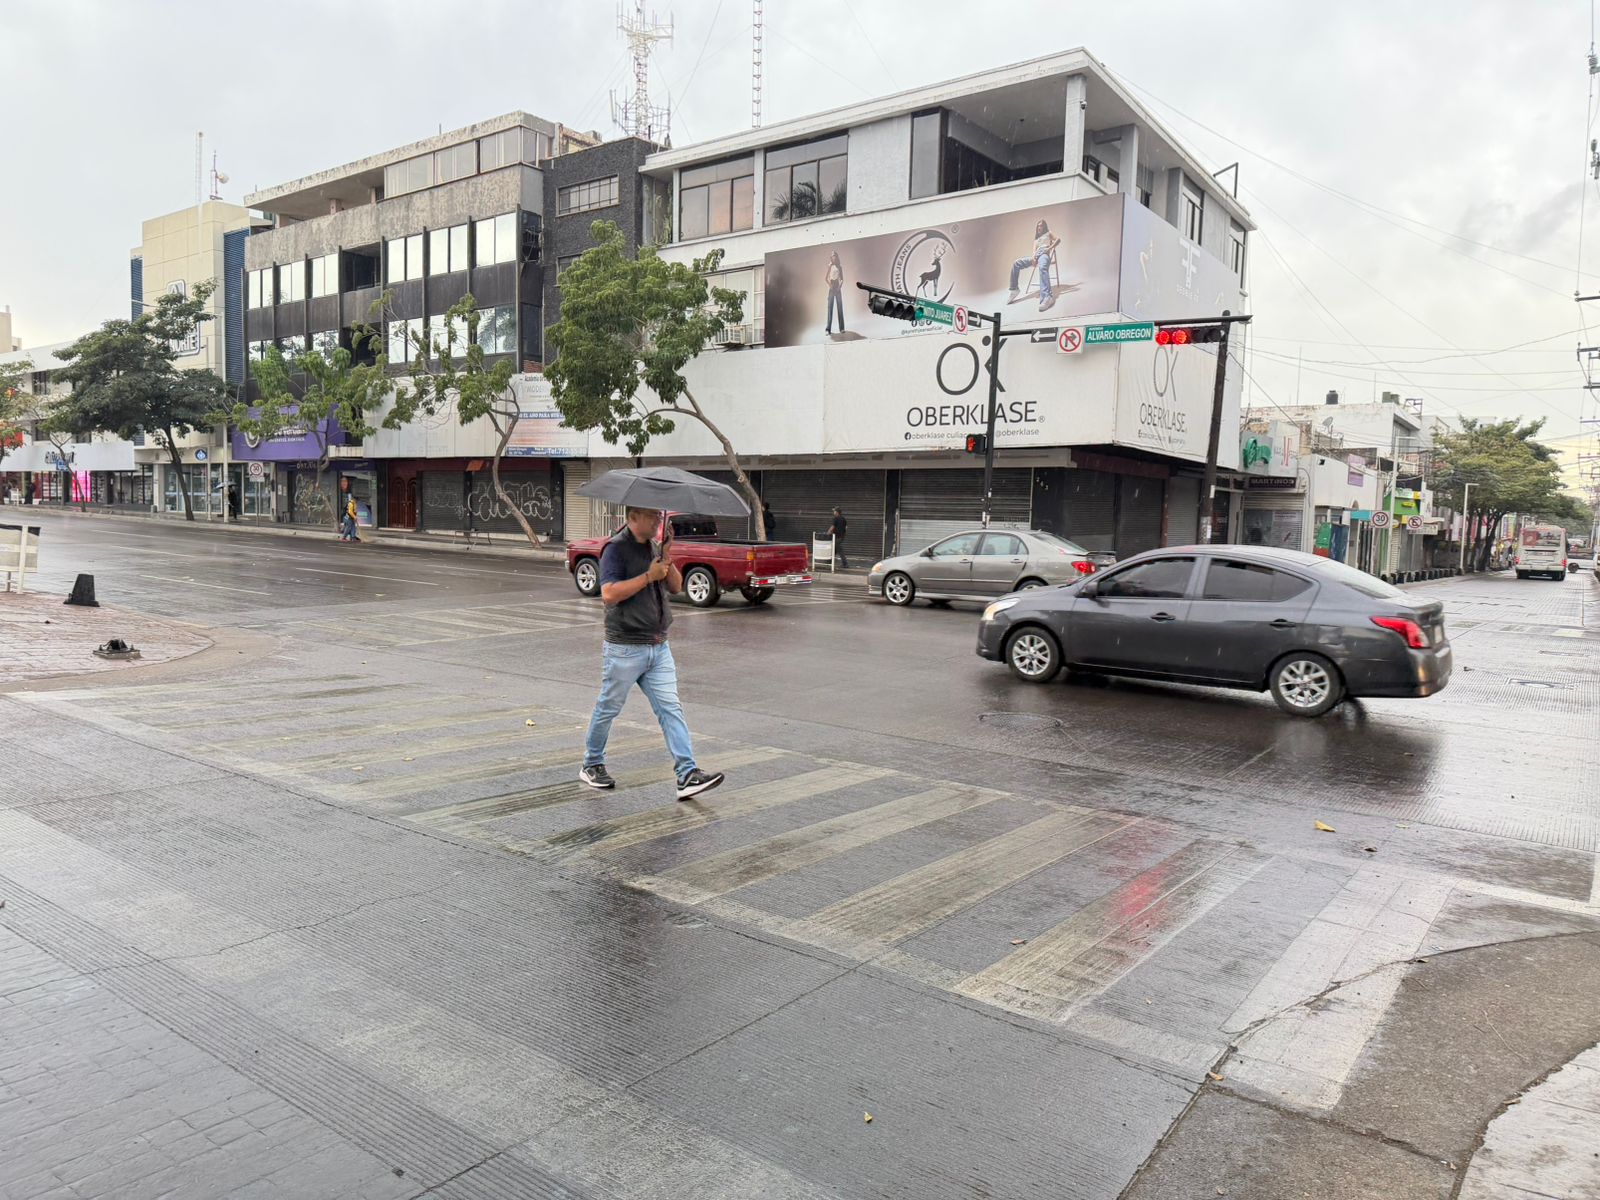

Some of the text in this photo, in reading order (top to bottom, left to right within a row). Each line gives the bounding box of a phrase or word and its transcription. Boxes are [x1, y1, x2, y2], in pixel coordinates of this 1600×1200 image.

[924, 306, 935, 318] NITO
[1087, 327, 1152, 341] ALVARO OBREGON
[907, 401, 1038, 427] OBERKLASE
[1140, 402, 1186, 433] OBERKLASE
[1376, 514, 1385, 522] 30
